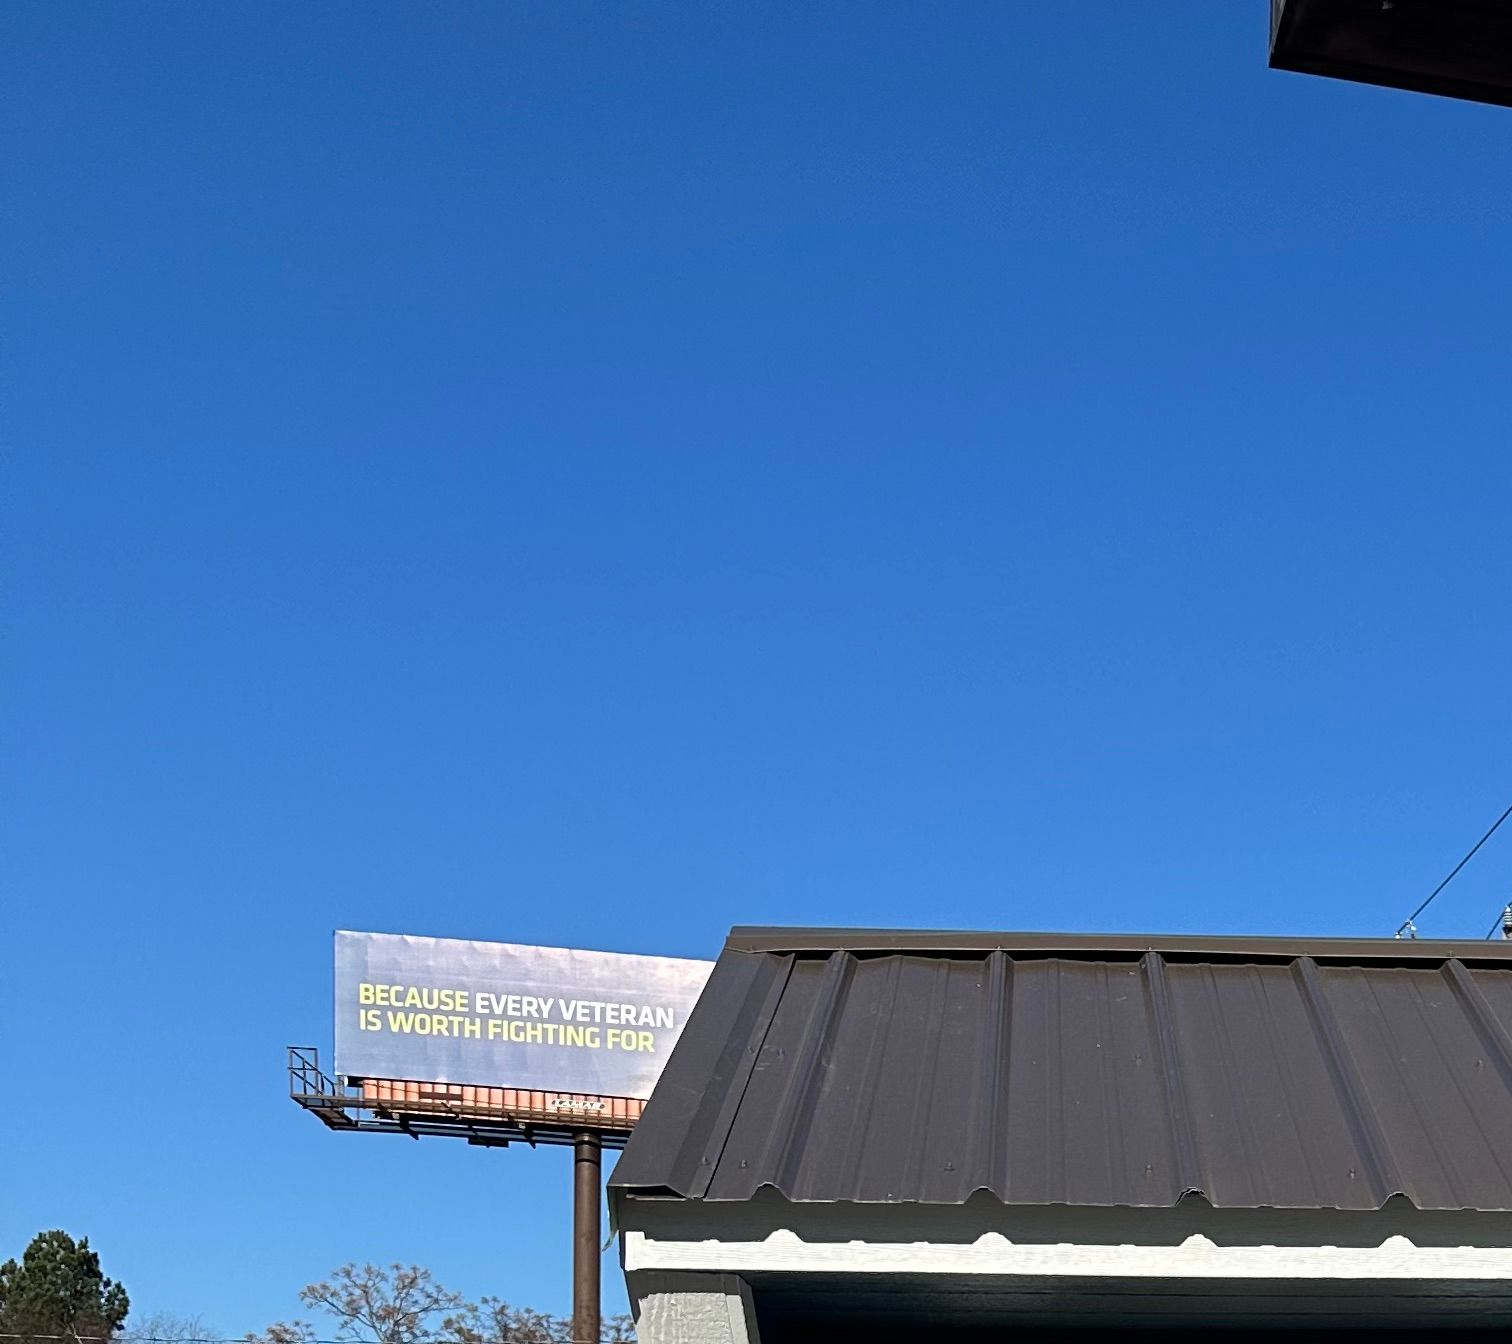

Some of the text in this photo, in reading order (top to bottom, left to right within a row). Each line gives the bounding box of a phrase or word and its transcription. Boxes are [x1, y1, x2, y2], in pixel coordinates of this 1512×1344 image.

[359, 983, 674, 1028] BECAUSE EVERY VETERAN
[359, 1009, 655, 1052] IS WORTH FIGHTING FOR
